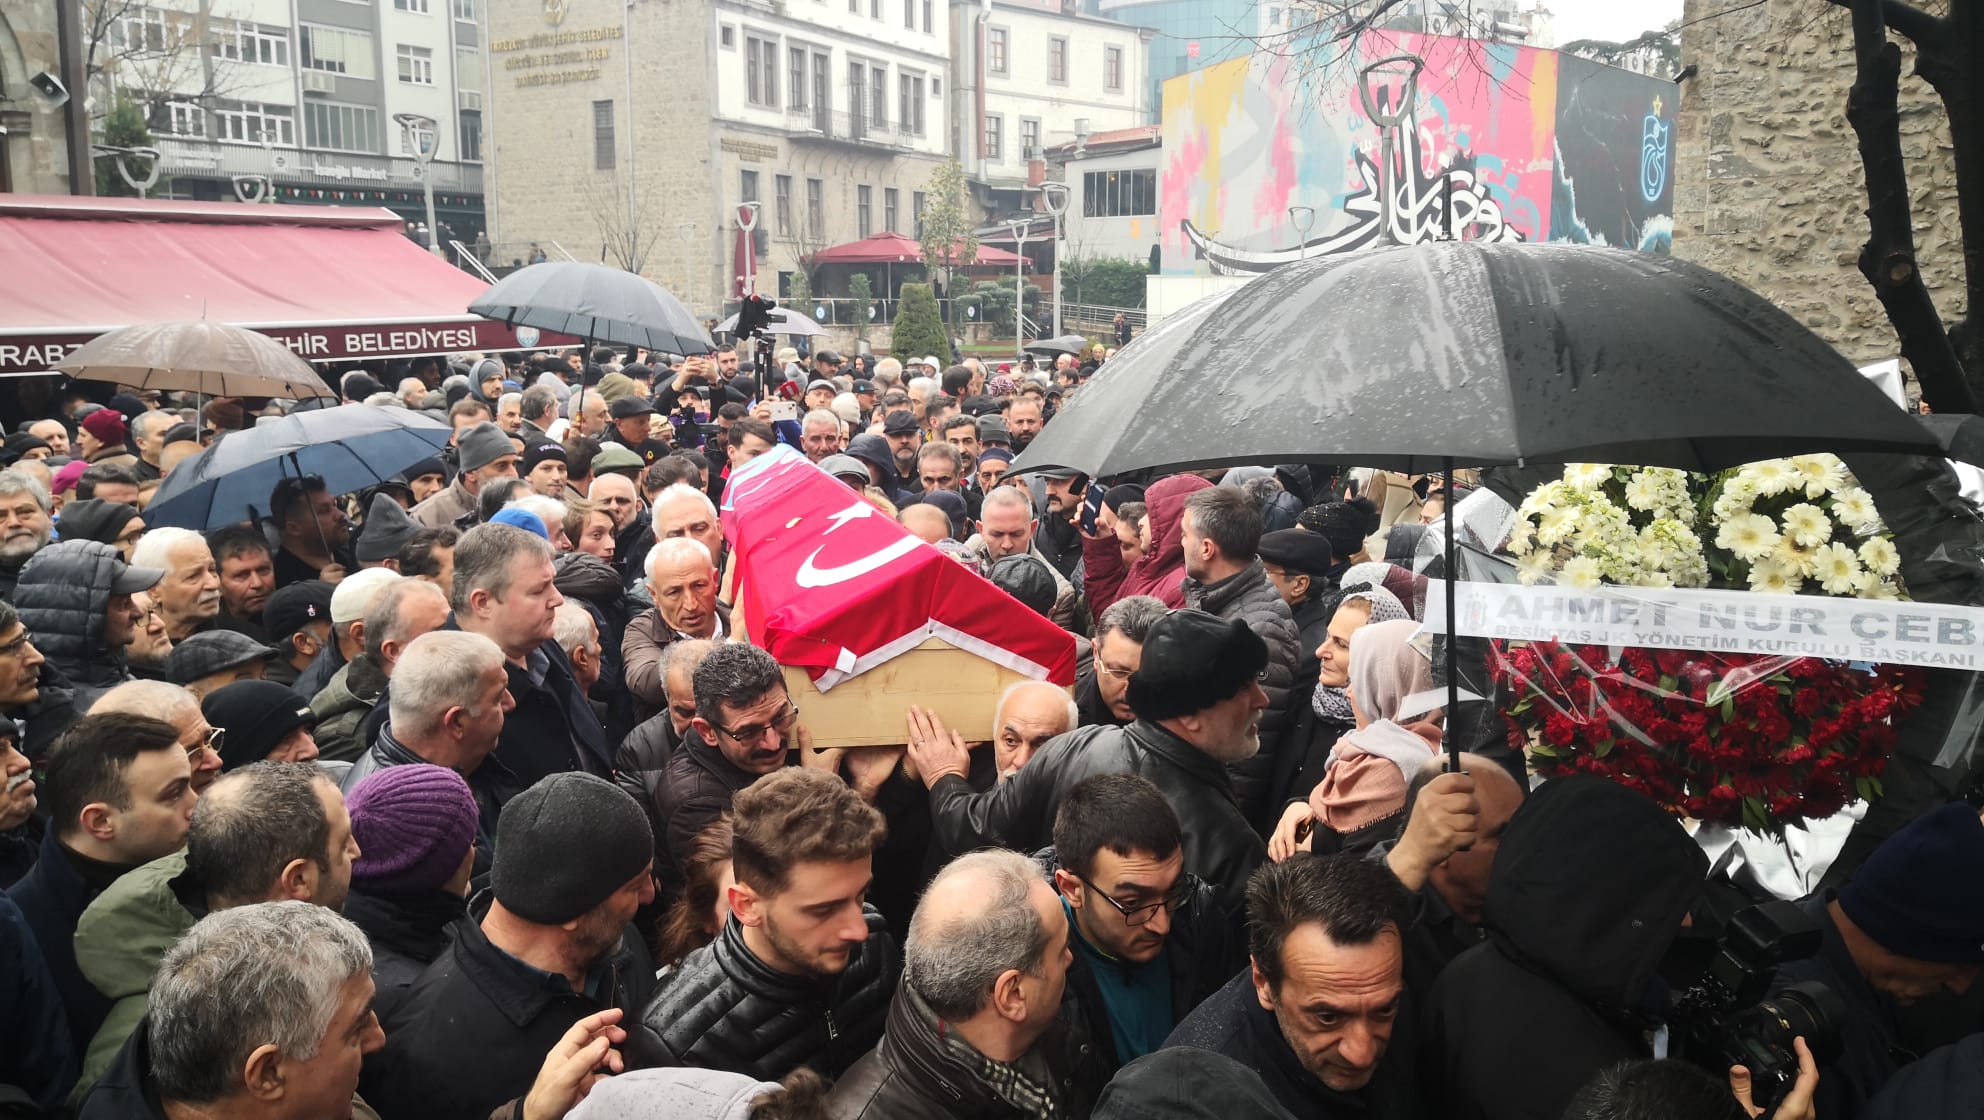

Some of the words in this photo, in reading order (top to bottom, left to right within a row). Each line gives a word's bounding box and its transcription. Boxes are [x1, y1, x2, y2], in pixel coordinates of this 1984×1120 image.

[345, 326, 477, 352] BELEDİYESİ
[1495, 594, 1677, 626] AHMET
[1699, 601, 1827, 636] NUR
[1850, 611, 1984, 646] ÇEB
[1634, 631, 1740, 650] YÖNETİM
[1747, 637, 1850, 656] KURULU
[1859, 647, 1976, 667] BAŞKANI
